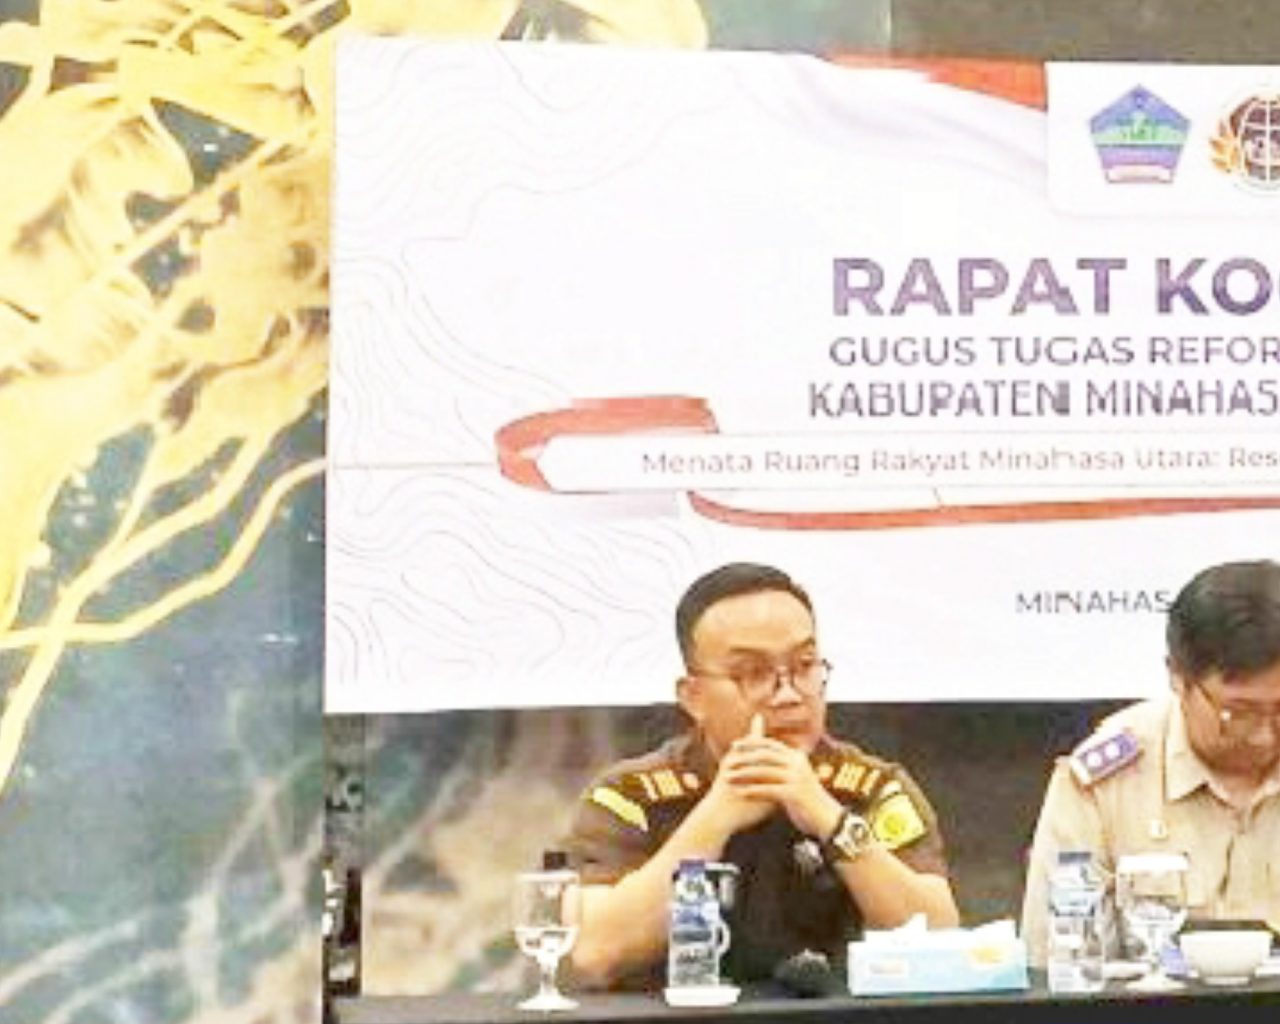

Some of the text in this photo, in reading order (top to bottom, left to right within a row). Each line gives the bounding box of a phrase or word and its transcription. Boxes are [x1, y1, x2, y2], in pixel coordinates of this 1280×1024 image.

[831, 256, 1128, 317] RAPAT
[828, 336, 977, 367] GUGUS
[988, 335, 1136, 367] TUGAS
[808, 380, 1071, 419] KABUPATEN
[640, 452, 755, 474] Menata
[764, 450, 861, 478] Ruang
[871, 448, 971, 478] Rakyat
[979, 447, 1126, 471] Minahasa
[1135, 446, 1221, 470] Utara:
[1015, 589, 1174, 614] MINAHAS
